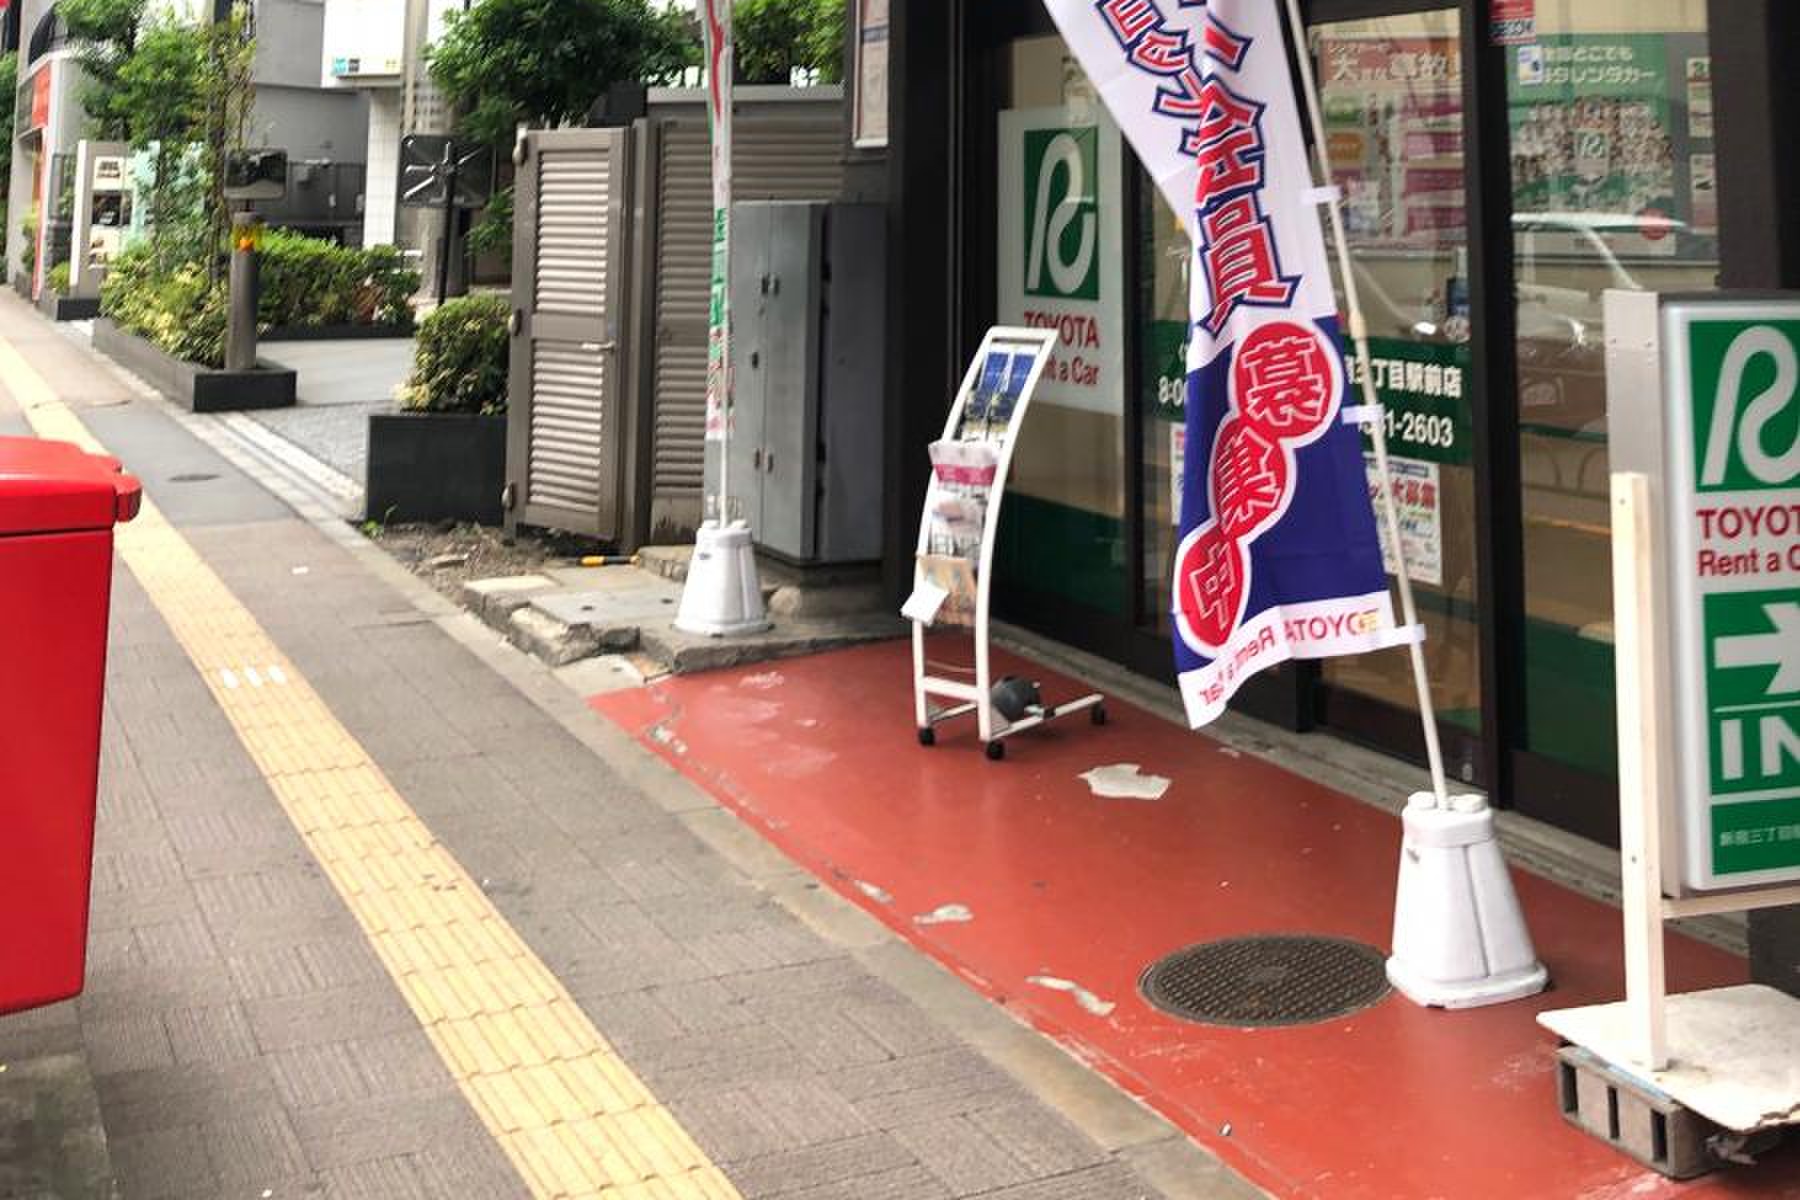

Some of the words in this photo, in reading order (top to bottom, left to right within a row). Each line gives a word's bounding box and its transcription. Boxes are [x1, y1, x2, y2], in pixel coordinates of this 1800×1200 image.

[1060, 362, 1069, 381] a
[1073, 356, 1100, 384] Car
[1345, 355, 1462, 398] 丁目駅前店
[1358, 409, 1454, 447] 1-2603
[1695, 504, 1800, 540] TOYO
[1698, 548, 1760, 577] Rent
[1766, 552, 1780, 573] a
[1720, 715, 1800, 781] IN
